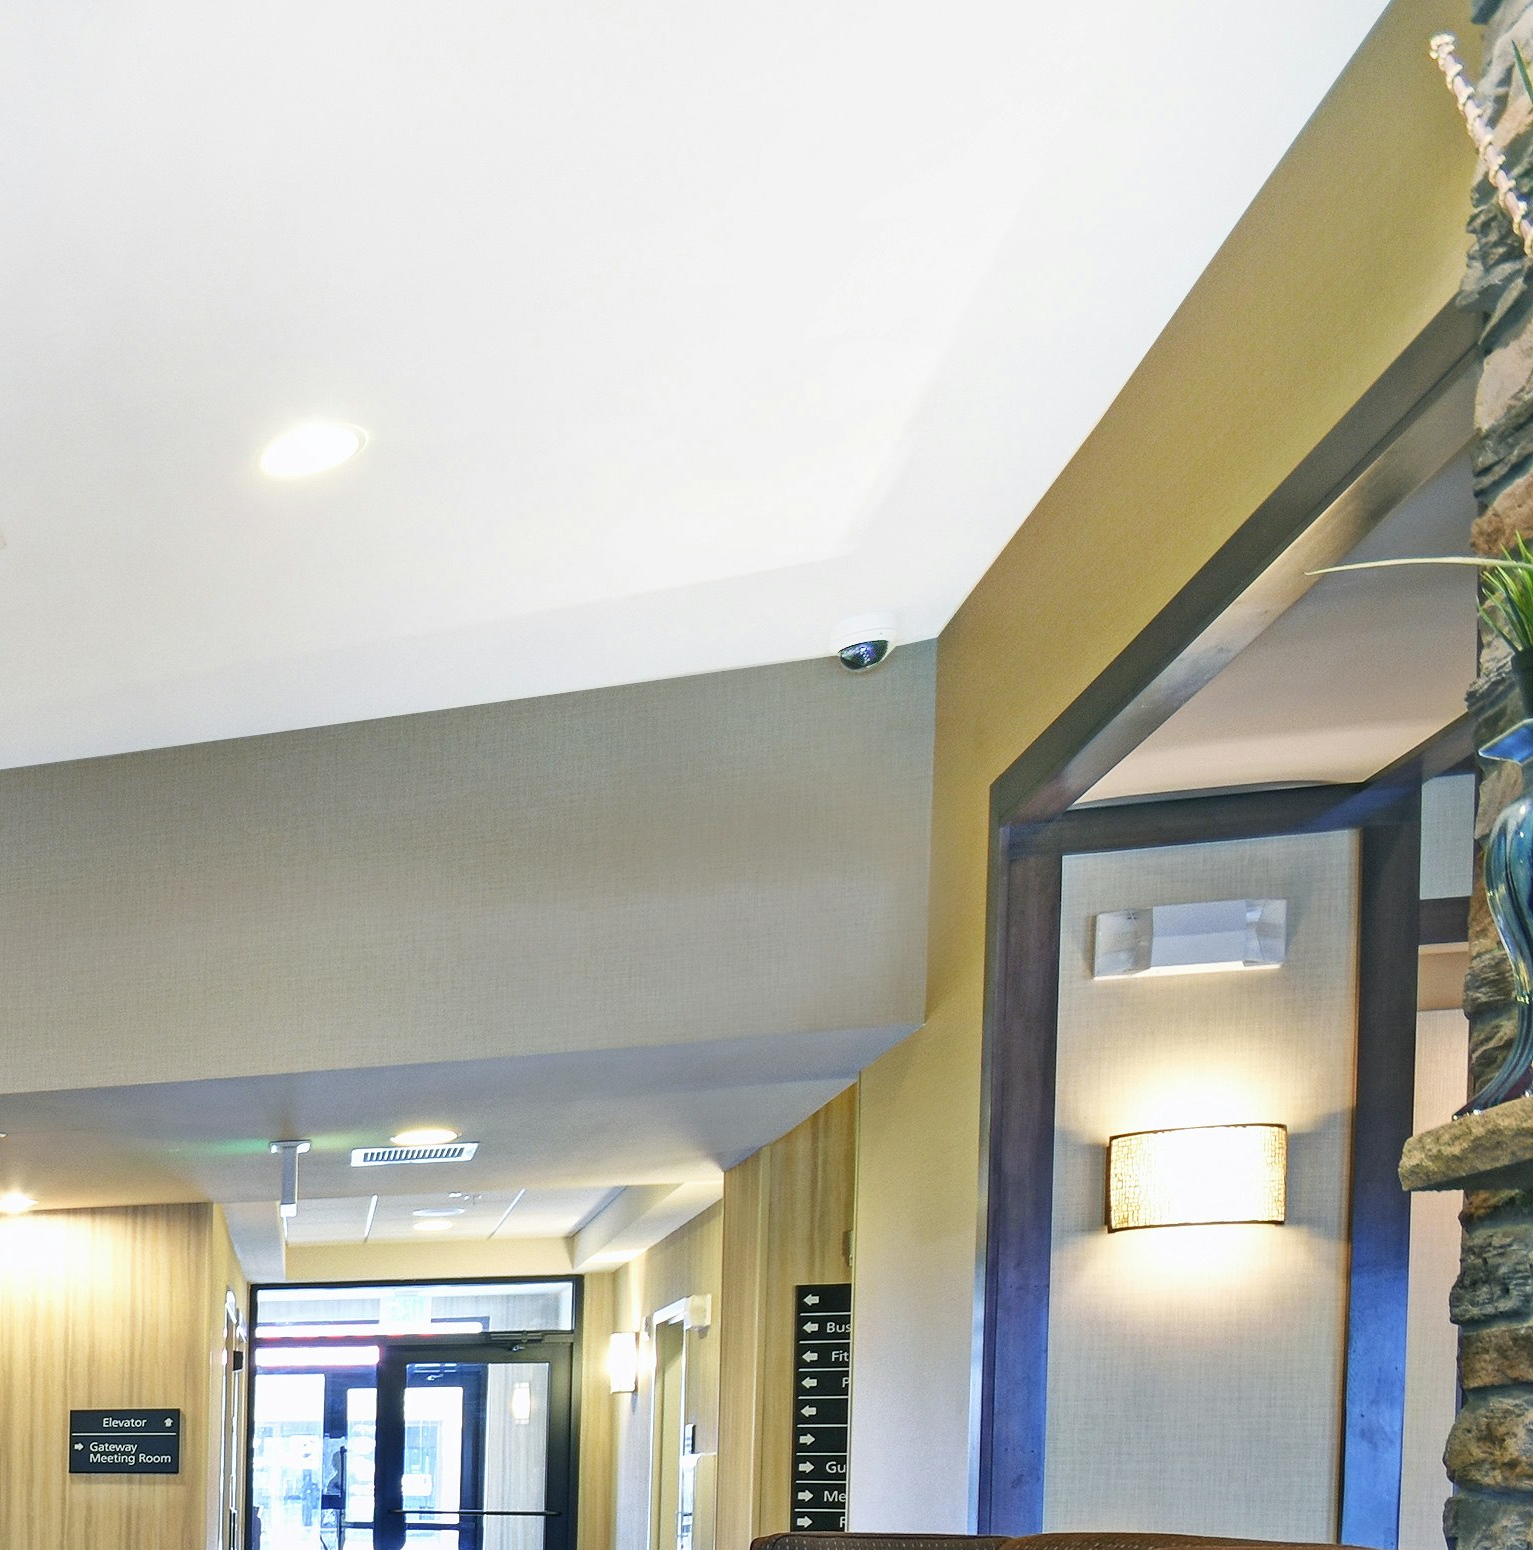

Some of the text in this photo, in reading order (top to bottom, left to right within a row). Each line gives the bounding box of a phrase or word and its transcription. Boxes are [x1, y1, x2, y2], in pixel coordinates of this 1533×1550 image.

[102, 1417, 147, 1428] Elevator
[89, 1442, 138, 1454] Gateway
[89, 1453, 172, 1465] Meeting Room
